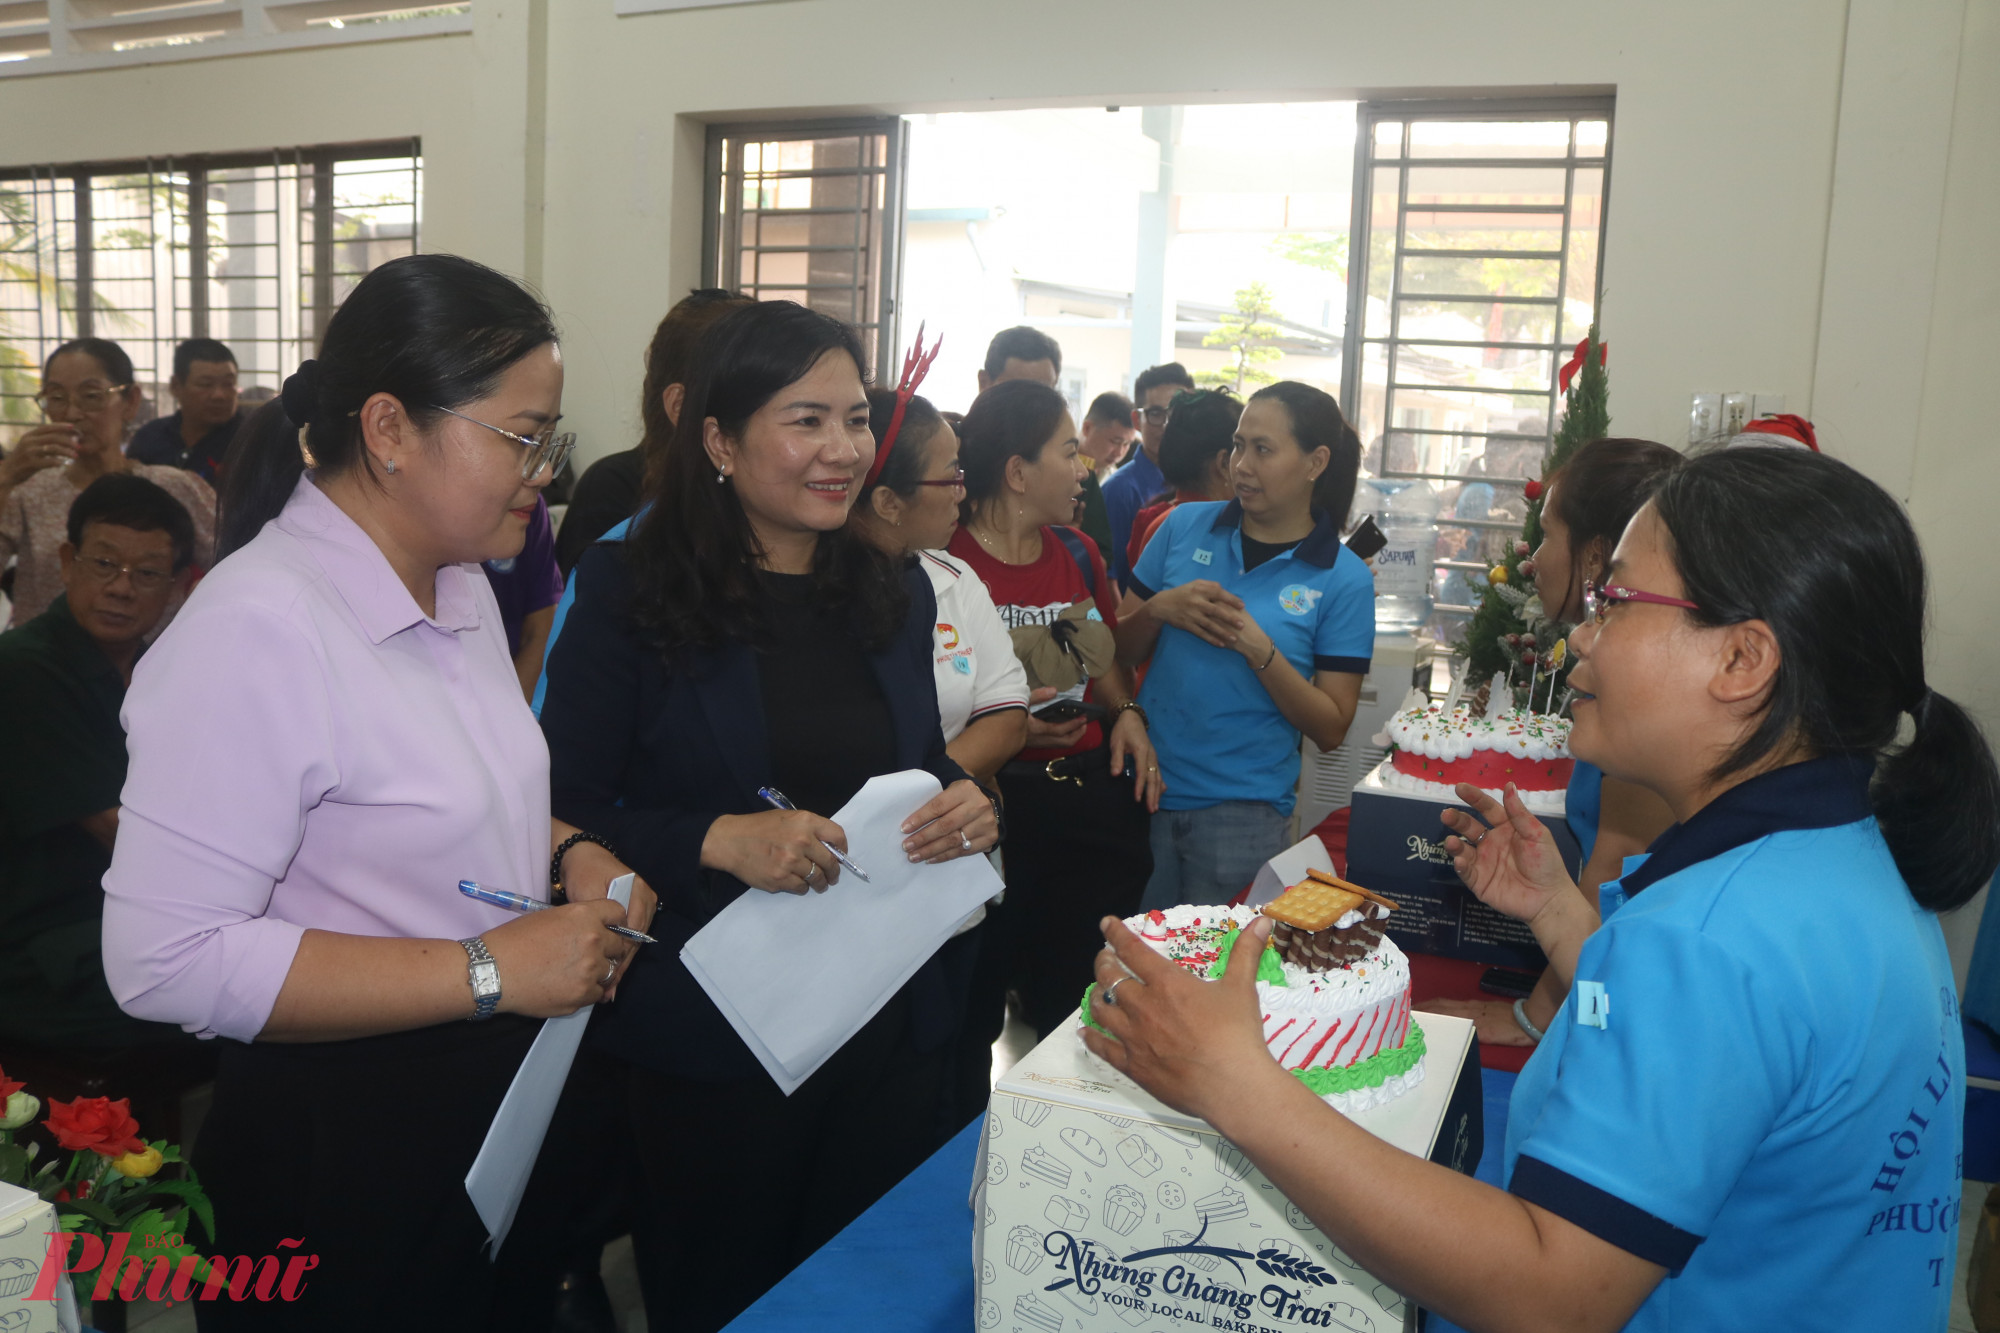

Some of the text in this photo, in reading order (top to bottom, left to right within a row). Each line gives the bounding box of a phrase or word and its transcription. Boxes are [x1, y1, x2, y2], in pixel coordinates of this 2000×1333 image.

[1101, 1291, 1145, 1311] YOUR
[1151, 1302, 1205, 1324] LOCAL
[1162, 1264, 1257, 1320] Chàng
[1260, 1284, 1332, 1328] Trai
